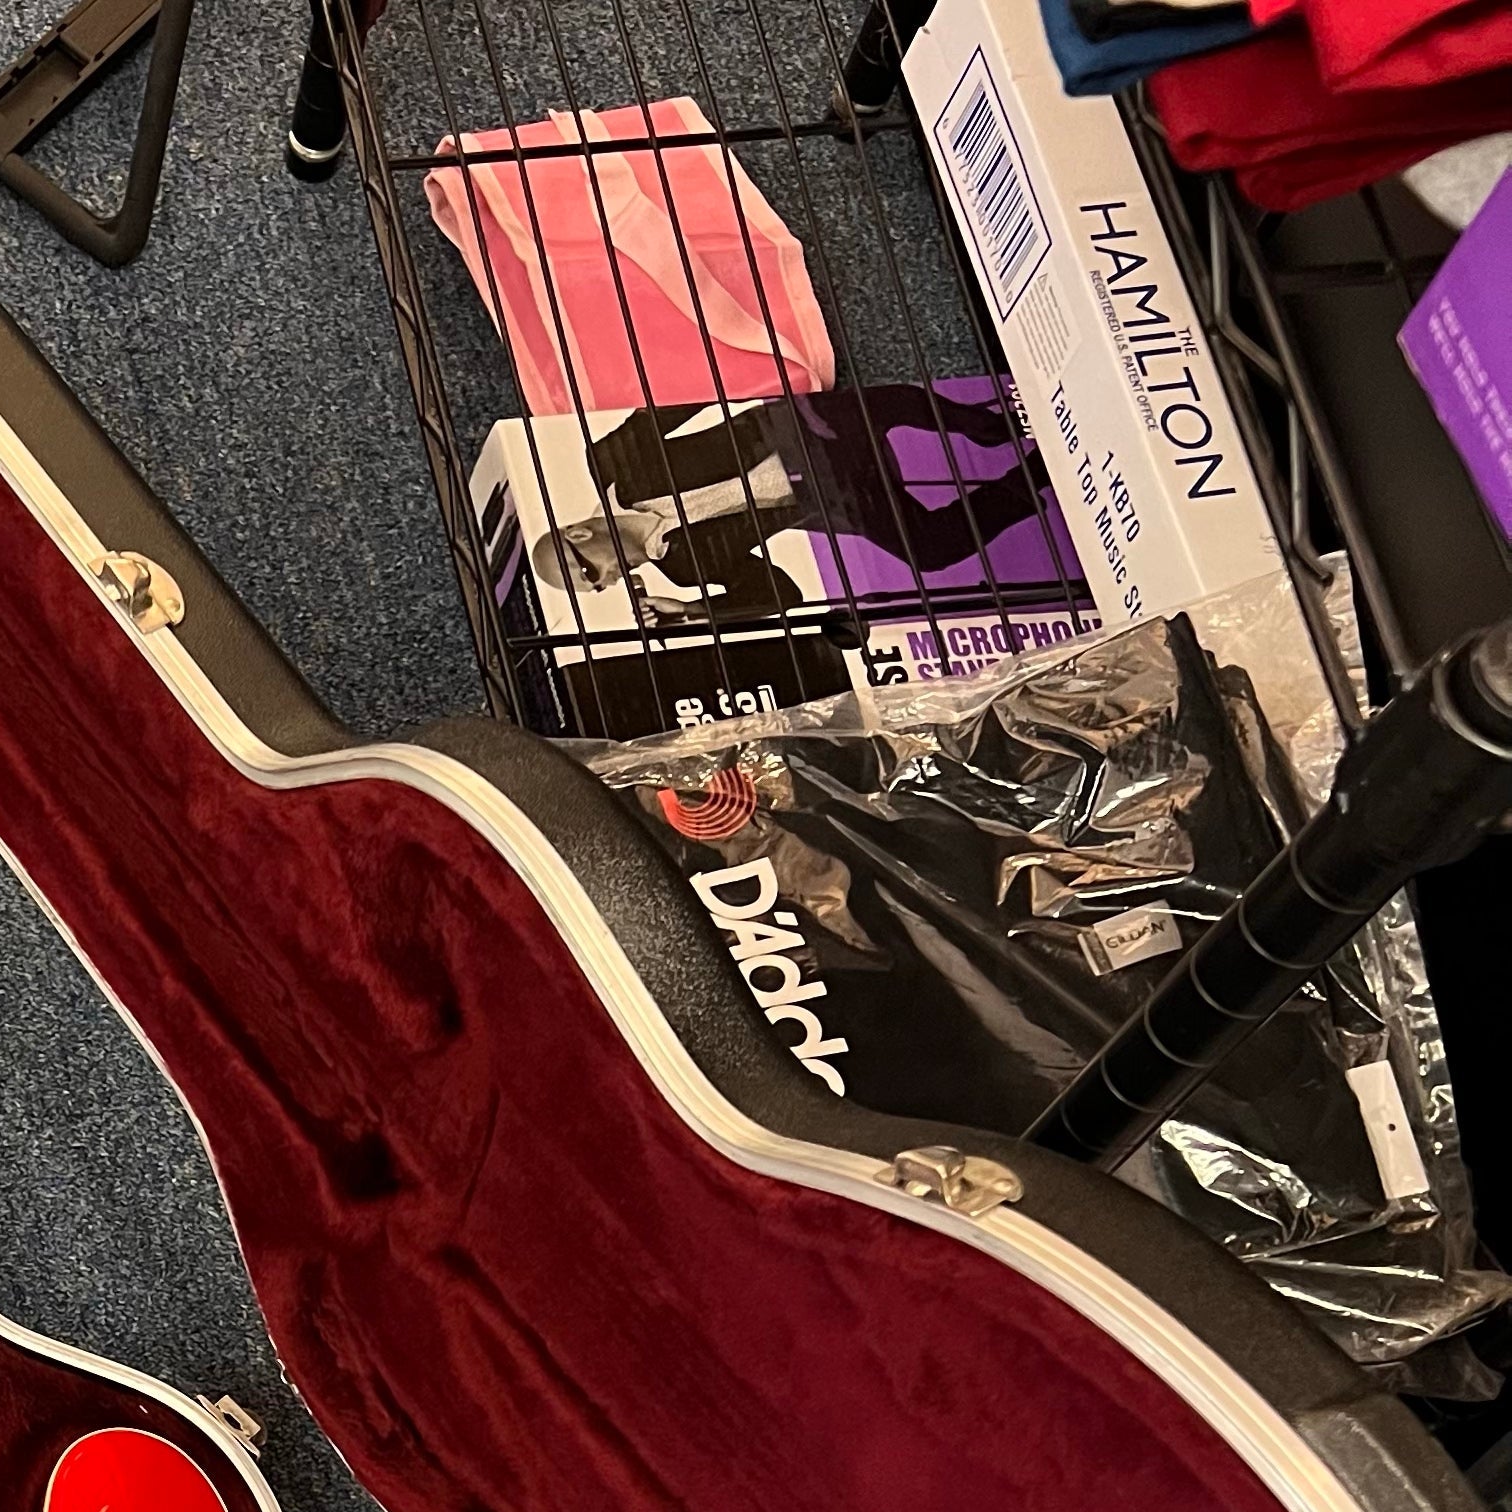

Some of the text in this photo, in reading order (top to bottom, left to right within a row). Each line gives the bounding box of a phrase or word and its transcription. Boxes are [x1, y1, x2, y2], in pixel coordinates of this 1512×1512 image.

[1079, 201, 1237, 500] HAMILTON
[1089, 269, 1122, 333] REGISTERED
[1121, 355, 1145, 393] PATENT
[1136, 394, 1160, 433] OFFICE
[1177, 325, 1200, 357] THE
[1050, 379, 1079, 455] Table
[1076, 451, 1099, 506] Top
[1094, 505, 1128, 586] Music
[1101, 450, 1141, 543] 1-KB70
